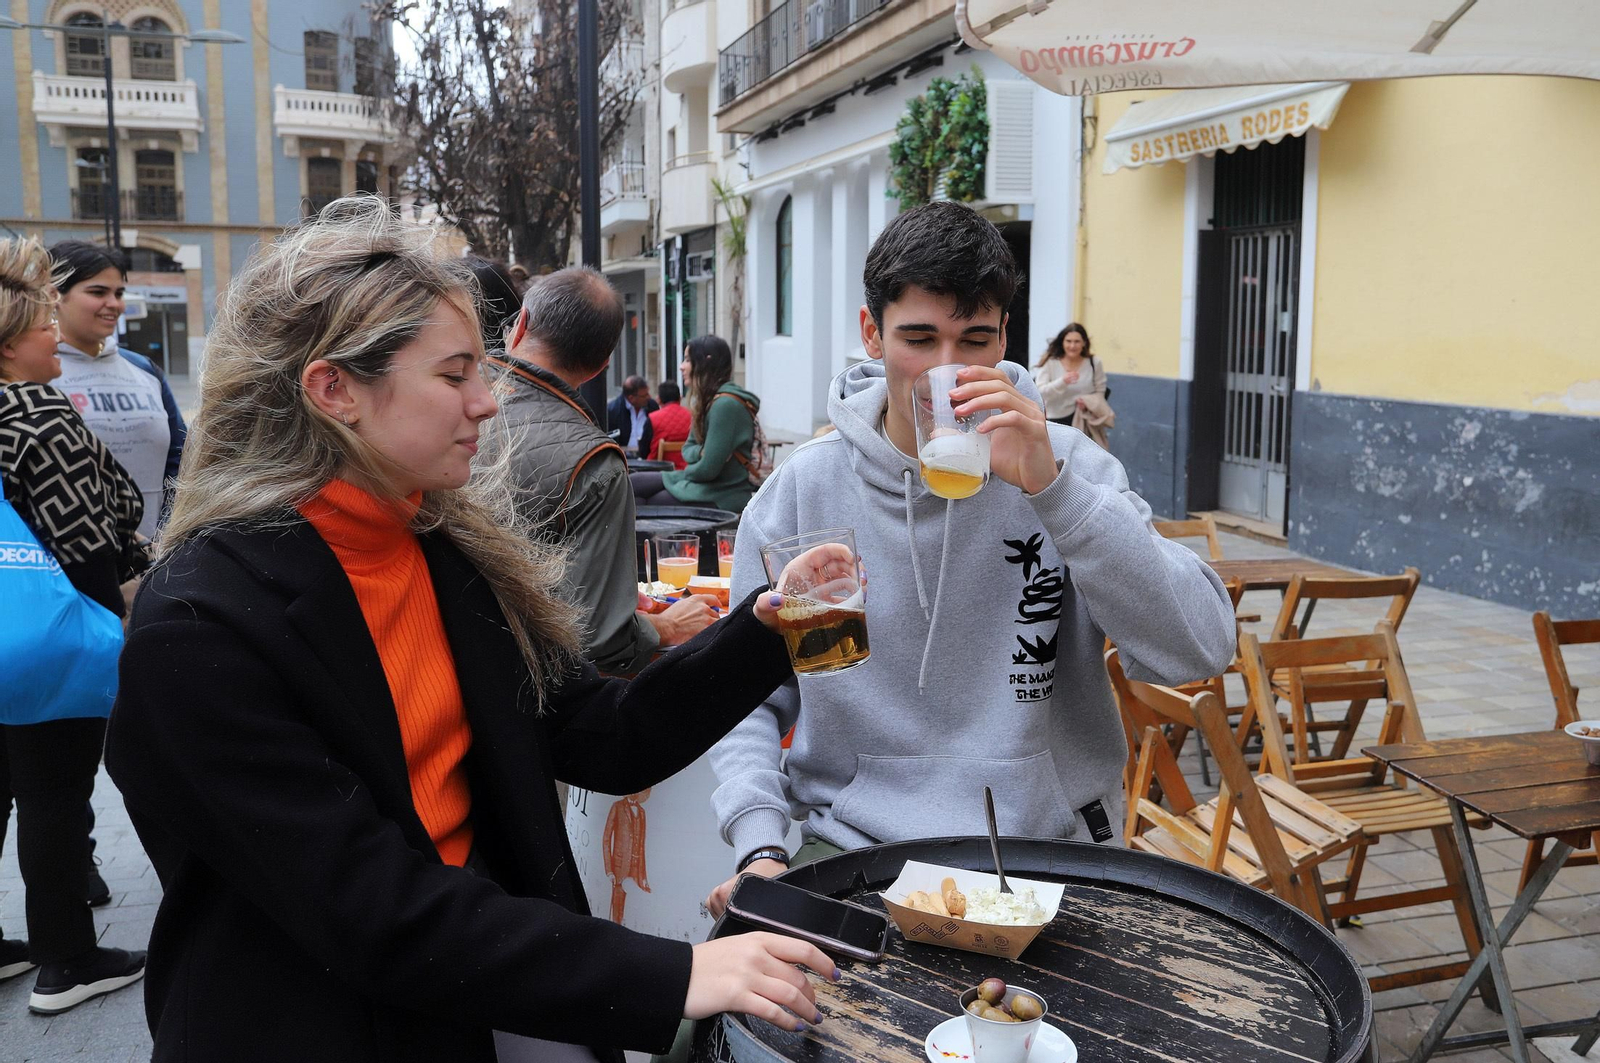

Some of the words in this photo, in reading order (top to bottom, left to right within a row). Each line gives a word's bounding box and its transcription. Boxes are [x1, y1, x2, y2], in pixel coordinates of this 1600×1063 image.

[1130, 122, 1230, 163] SASTRERIA
[1241, 101, 1310, 140] RODES
[69, 387, 162, 413] PÍNOLA
[1009, 673, 1027, 685] THE
[1015, 688, 1041, 700] THE
